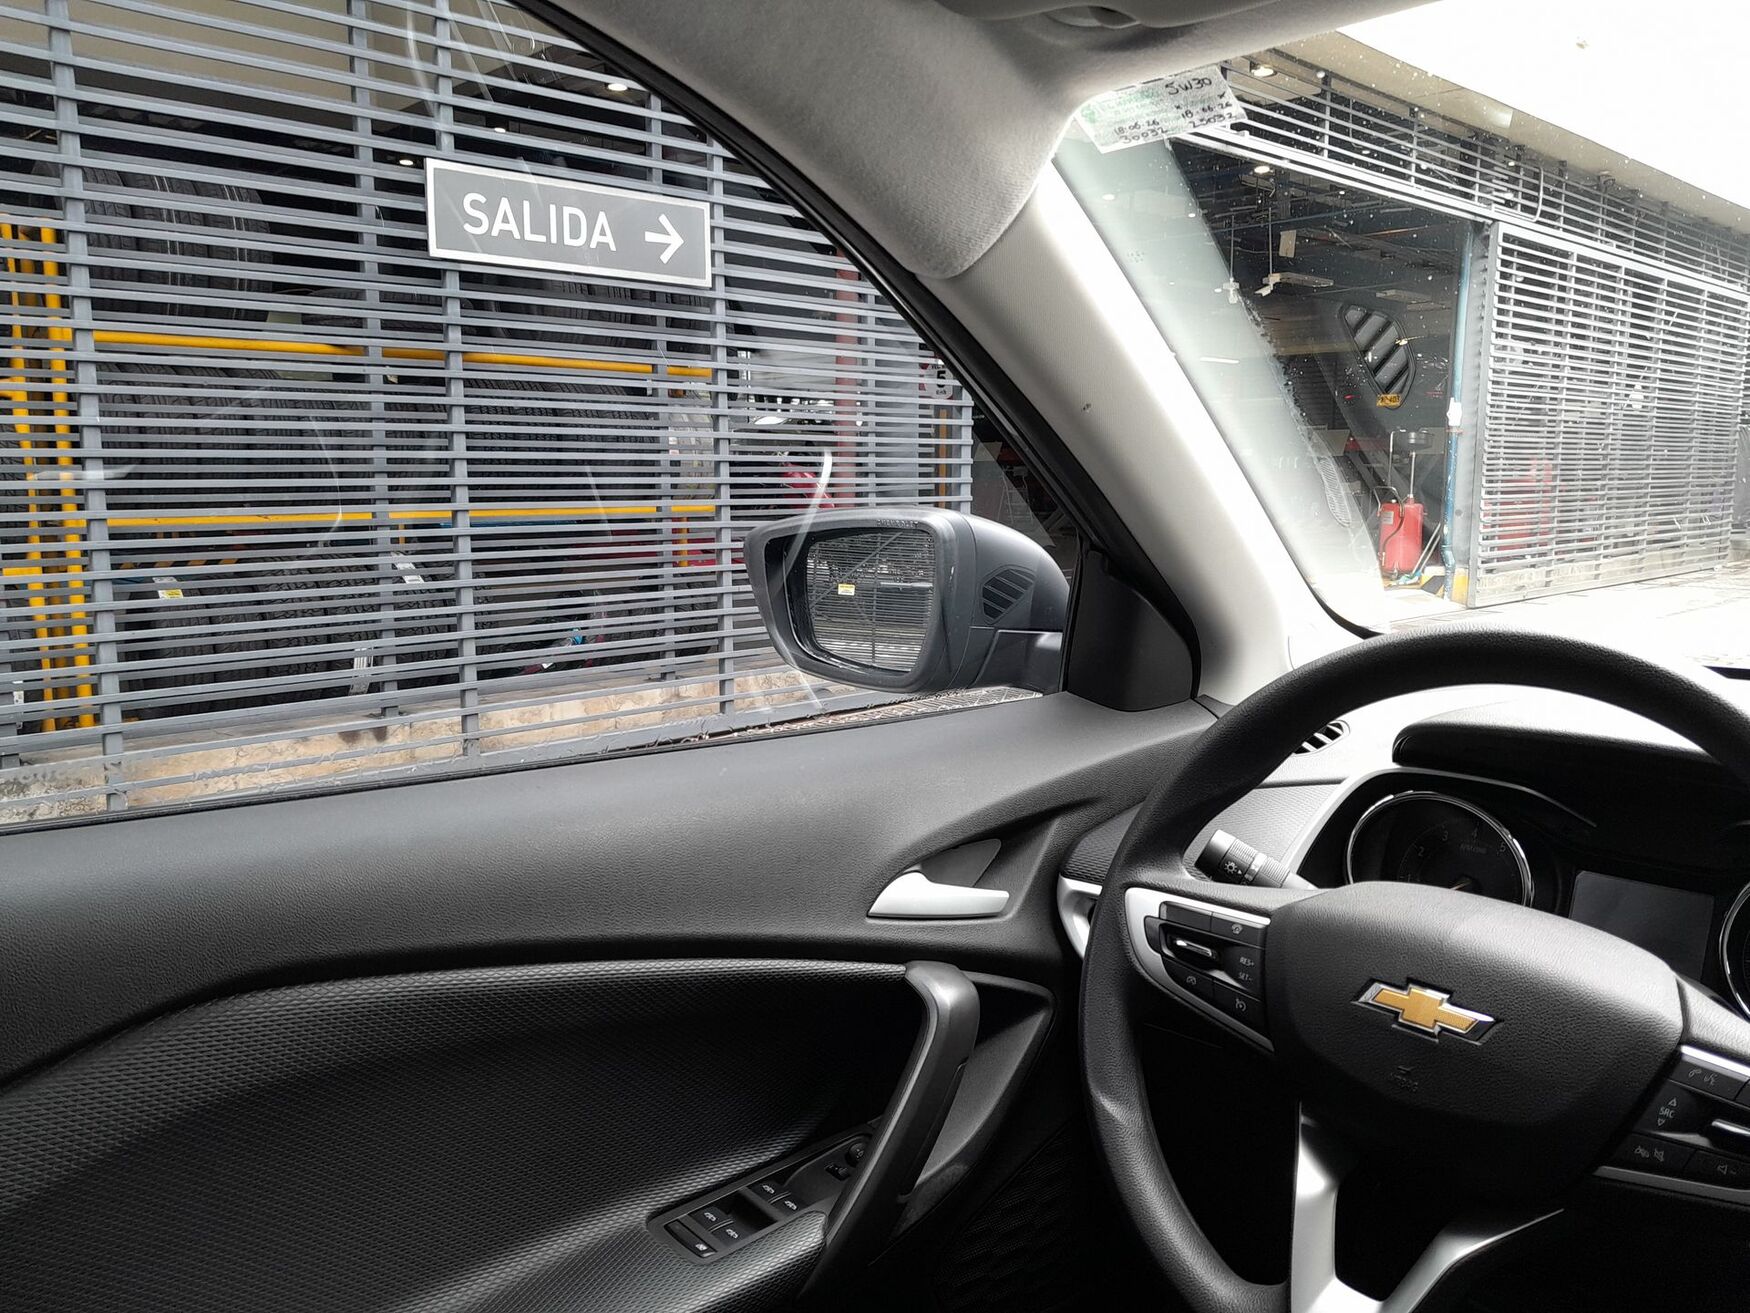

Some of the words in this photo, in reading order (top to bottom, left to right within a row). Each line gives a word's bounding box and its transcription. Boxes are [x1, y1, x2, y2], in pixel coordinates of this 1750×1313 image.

[1165, 77, 1212, 96] 5W30
[463, 192, 617, 251] SALIDA
[936, 370, 947, 388] 5
[1659, 1106, 1676, 1119] SRC
